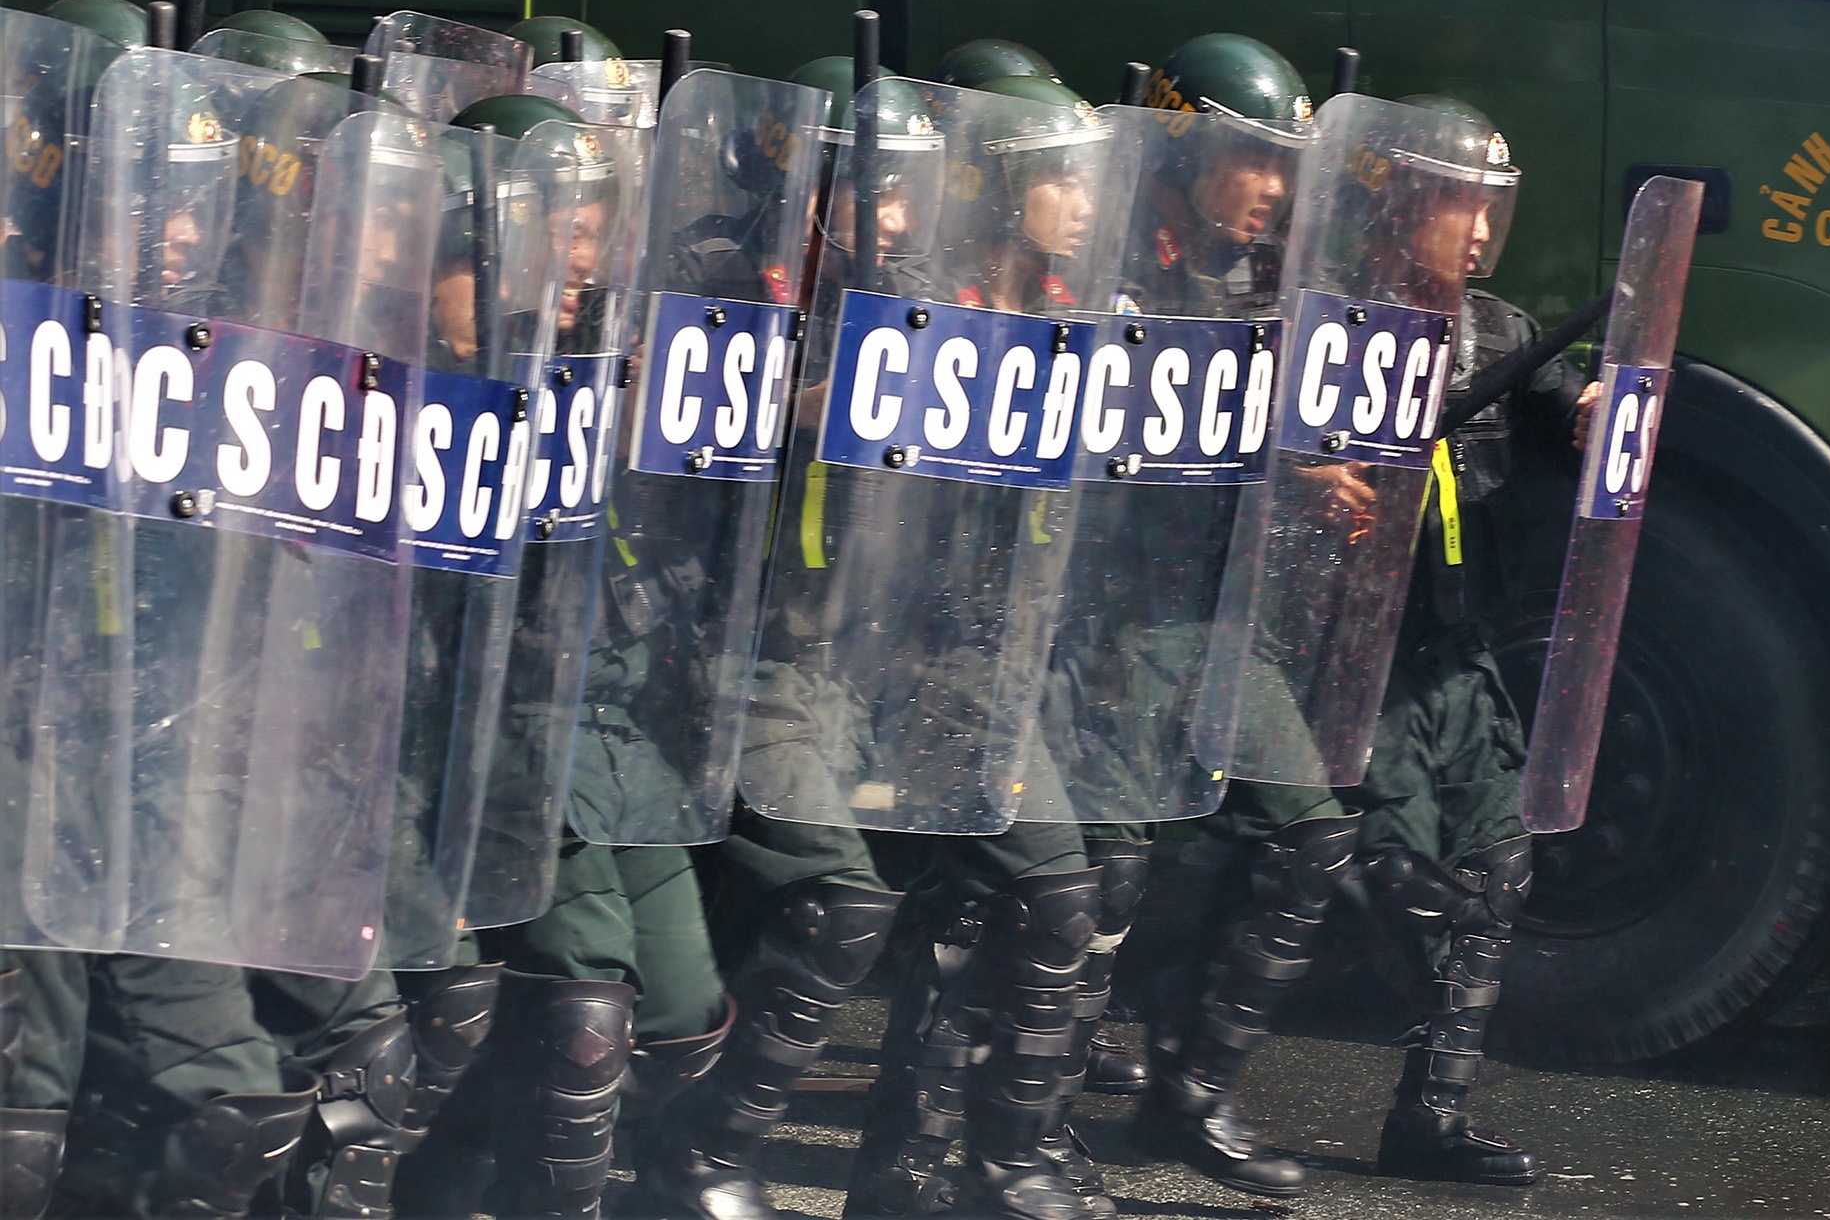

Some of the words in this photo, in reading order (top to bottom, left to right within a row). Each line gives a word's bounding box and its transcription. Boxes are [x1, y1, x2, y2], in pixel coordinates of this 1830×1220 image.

[129, 345, 398, 523] CSCĐ
[849, 326, 1082, 460] CSCĐ
[1081, 343, 1275, 457] CSCĐ
